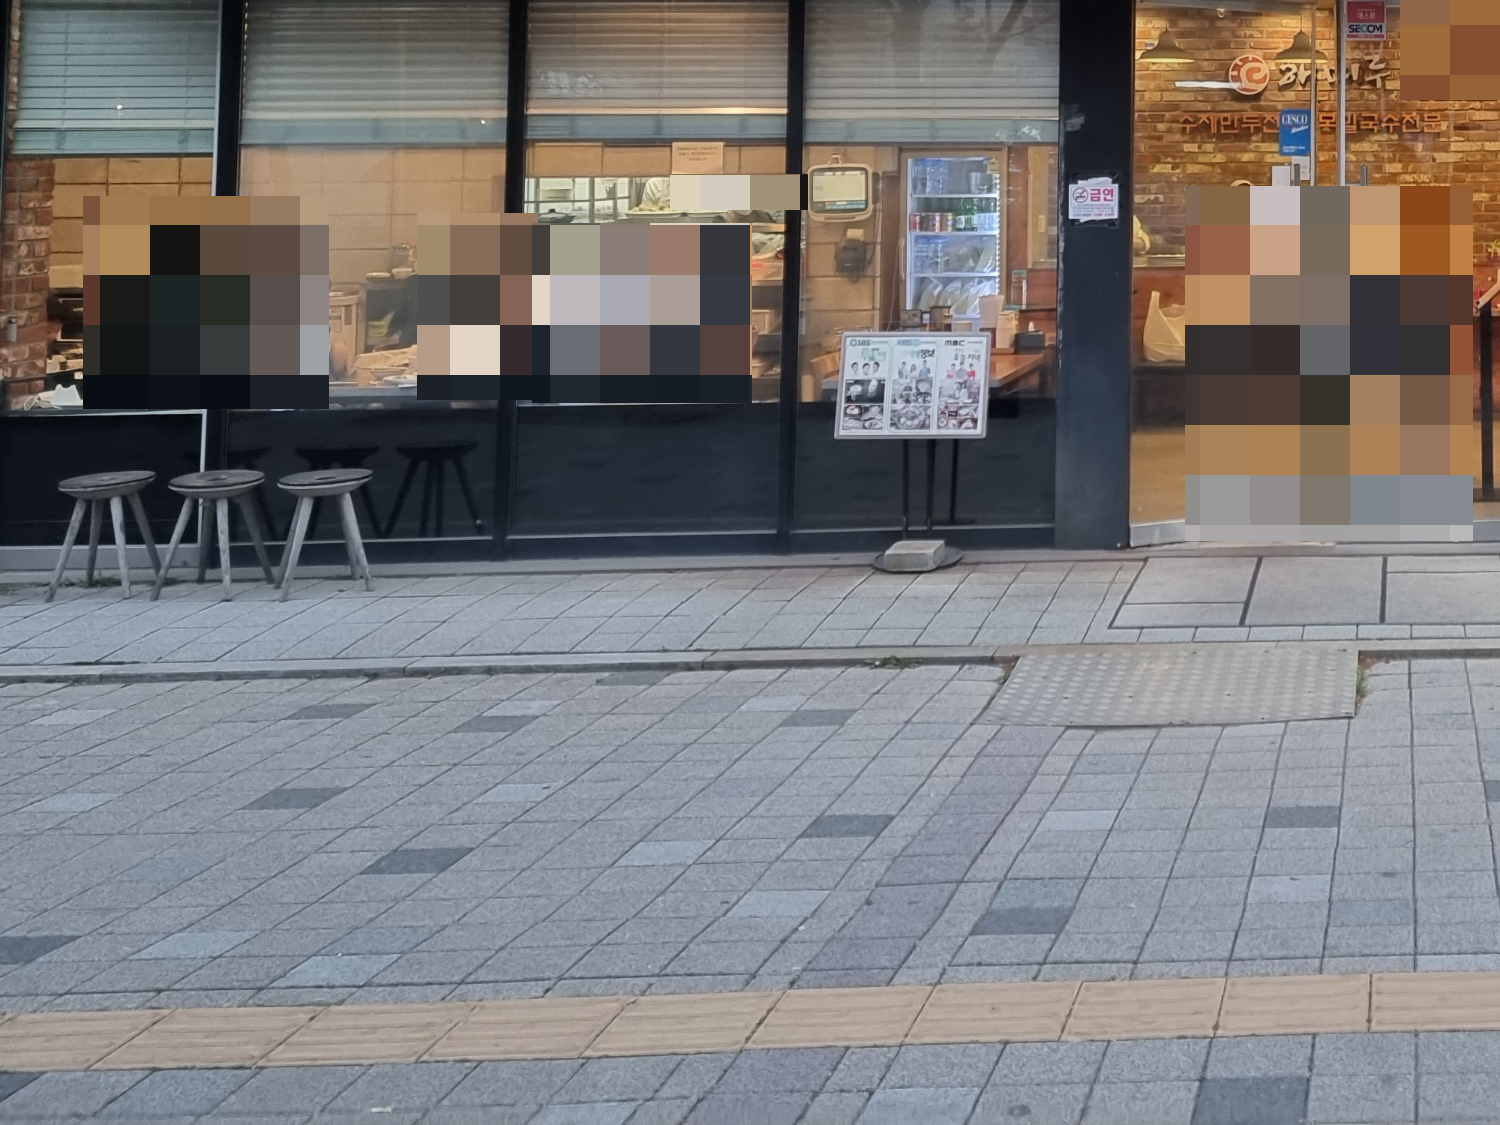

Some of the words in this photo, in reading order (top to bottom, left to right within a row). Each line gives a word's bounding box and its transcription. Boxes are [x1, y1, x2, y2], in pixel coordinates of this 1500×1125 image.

[1348, 24, 1383, 34] SECOM
[1281, 114, 1308, 125] CESCO
[1090, 188, 1114, 202] 금연
